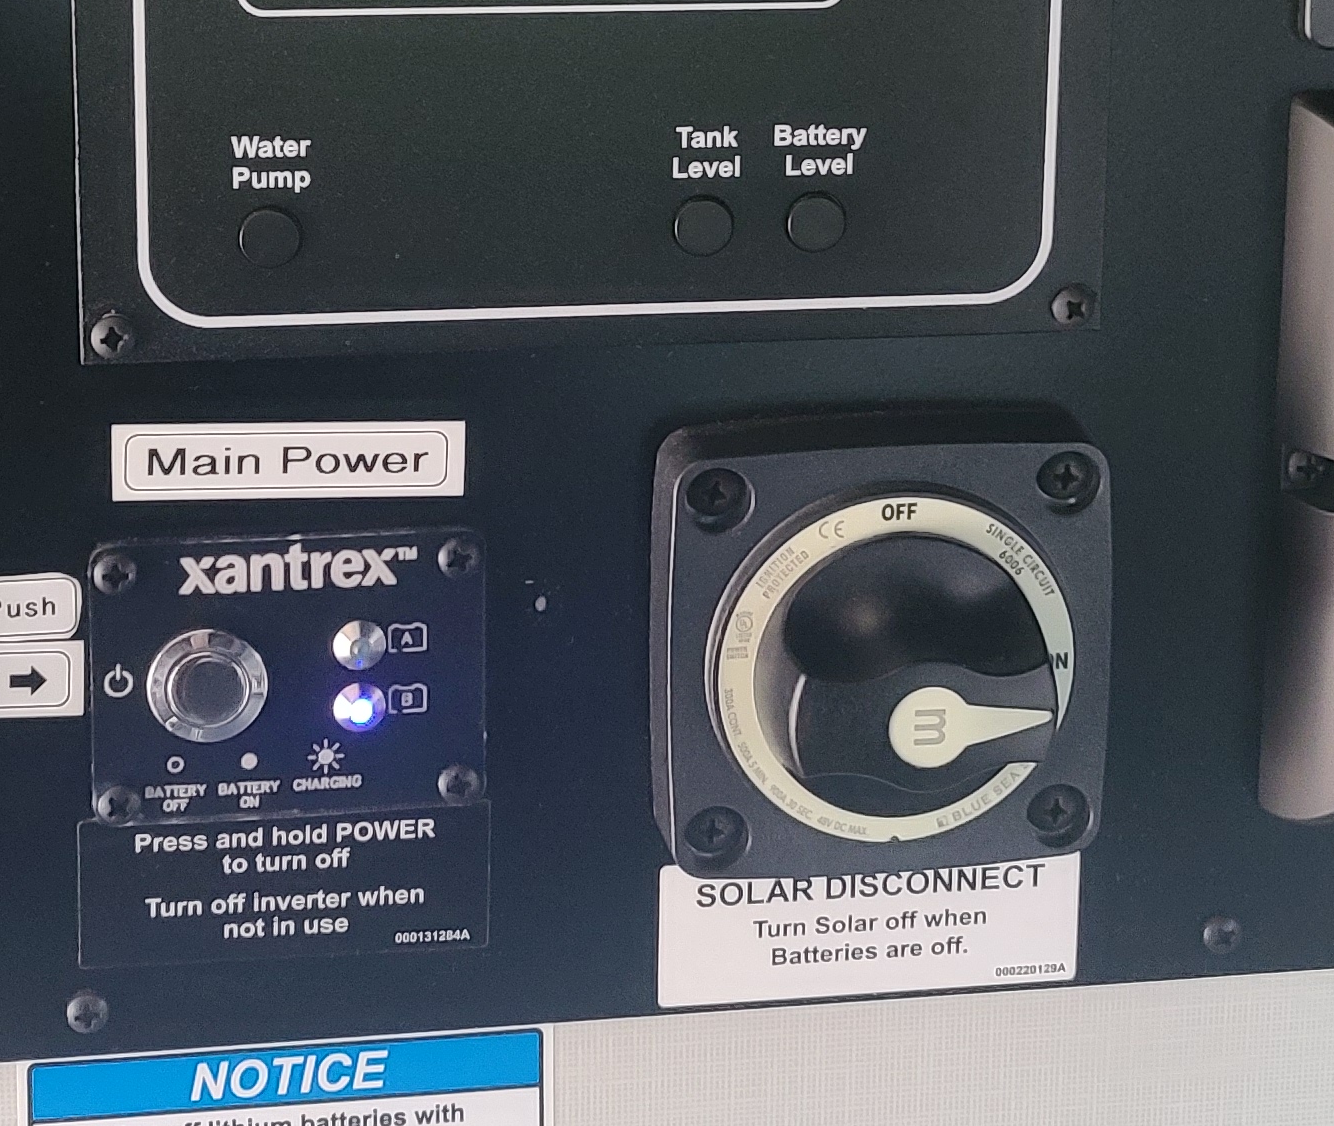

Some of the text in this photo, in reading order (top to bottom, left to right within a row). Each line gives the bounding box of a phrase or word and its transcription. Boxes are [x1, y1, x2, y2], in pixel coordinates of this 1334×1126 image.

[231, 135, 311, 160] Water
[675, 126, 738, 148] Tank
[773, 124, 867, 151] Battery
[672, 156, 741, 180] Level
[785, 153, 854, 177] Level
[232, 167, 311, 192] Pump
[148, 445, 429, 476] Main Power
[881, 502, 918, 521] OFF
[986, 523, 1055, 597] SINGLE CIRCUIT
[998, 550, 1026, 576] 6006
[401, 631, 413, 646] A
[144, 784, 207, 799] BATTERY
[218, 780, 280, 795] BATTERY
[292, 774, 363, 791] CHARGING
[163, 799, 189, 812] OFF
[239, 796, 260, 809] ON
[951, 770, 1021, 823] BLUE SEA
[135, 818, 436, 854] Press and hold POWER
[222, 848, 351, 874] to turn off
[695, 863, 1046, 908] SOLAR DISCONNECT
[145, 897, 204, 919] Turn
[211, 893, 246, 915] off
[358, 885, 425, 907] when
[223, 917, 349, 939] not in use
[753, 908, 987, 939] Turn Solar off when
[771, 935, 969, 966] Batteries are off.
[190, 1050, 389, 1102] NOTICE
[415, 1103, 464, 1124] with
